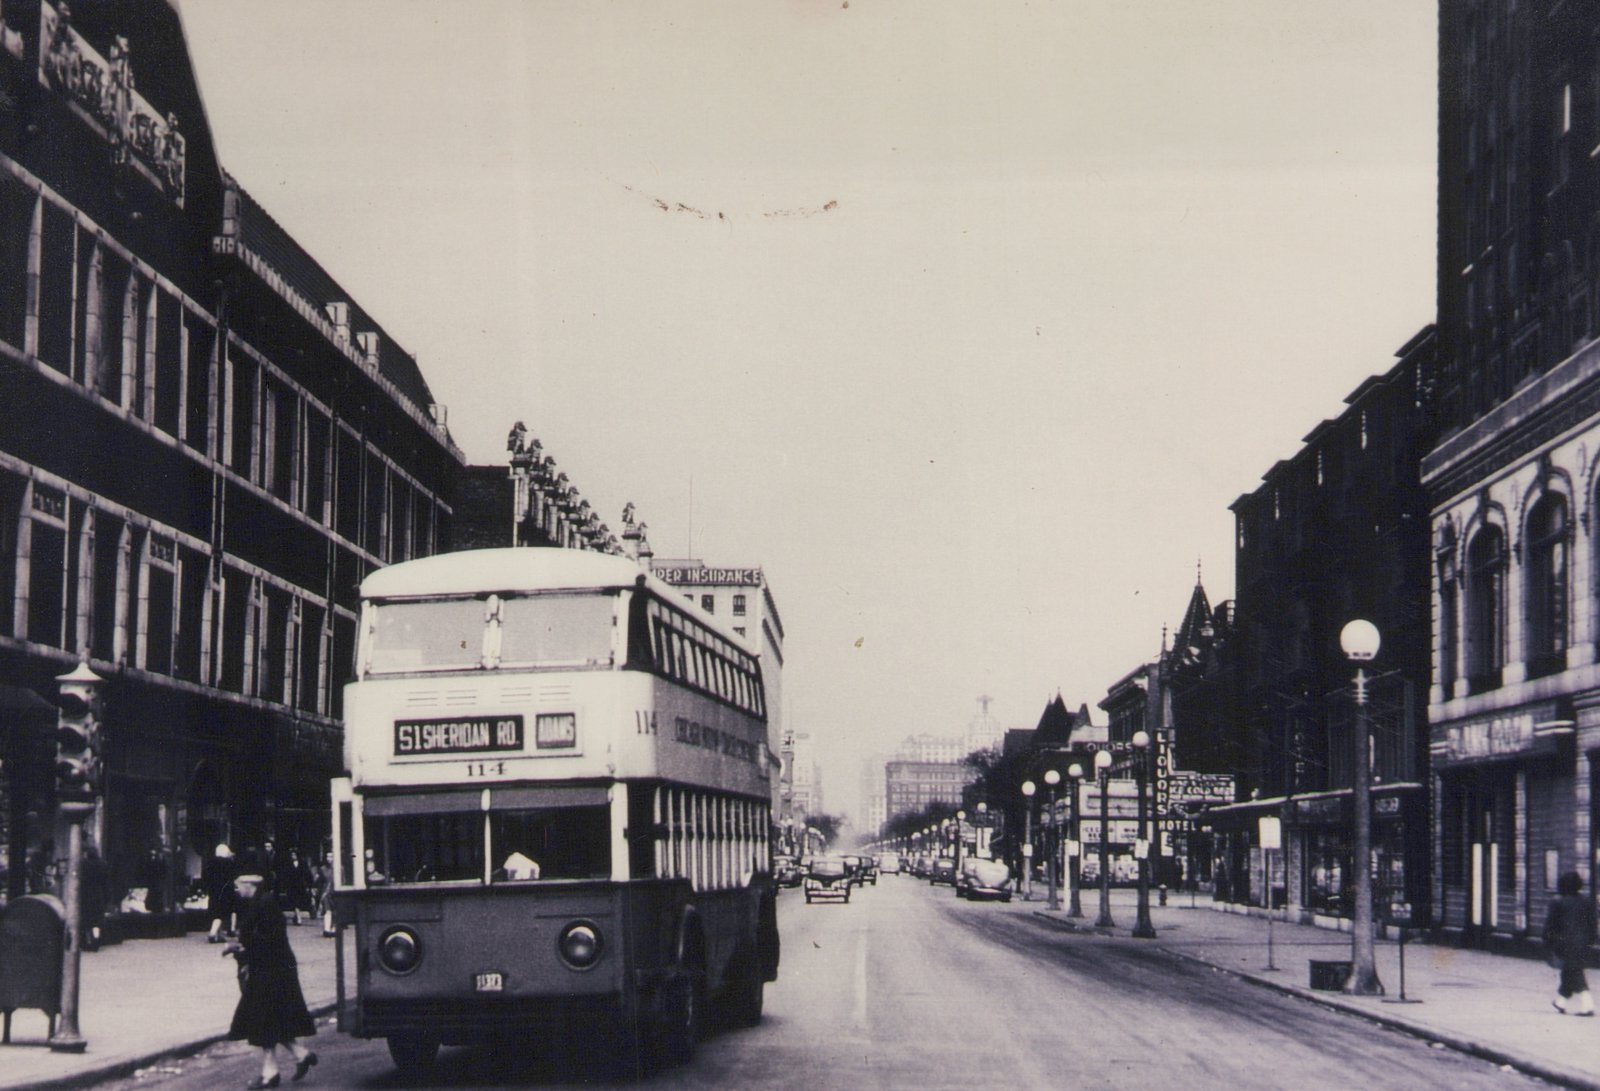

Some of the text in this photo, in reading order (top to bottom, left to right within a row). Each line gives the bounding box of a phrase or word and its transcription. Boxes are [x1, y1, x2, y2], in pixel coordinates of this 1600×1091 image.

[653, 568, 761, 584] PER INSURANCE
[423, 722, 489, 751] SHERIDAN
[467, 762, 507, 777] 114
[1156, 732, 1168, 816] LIQUORS
[1158, 820, 1197, 832] HOTEL
